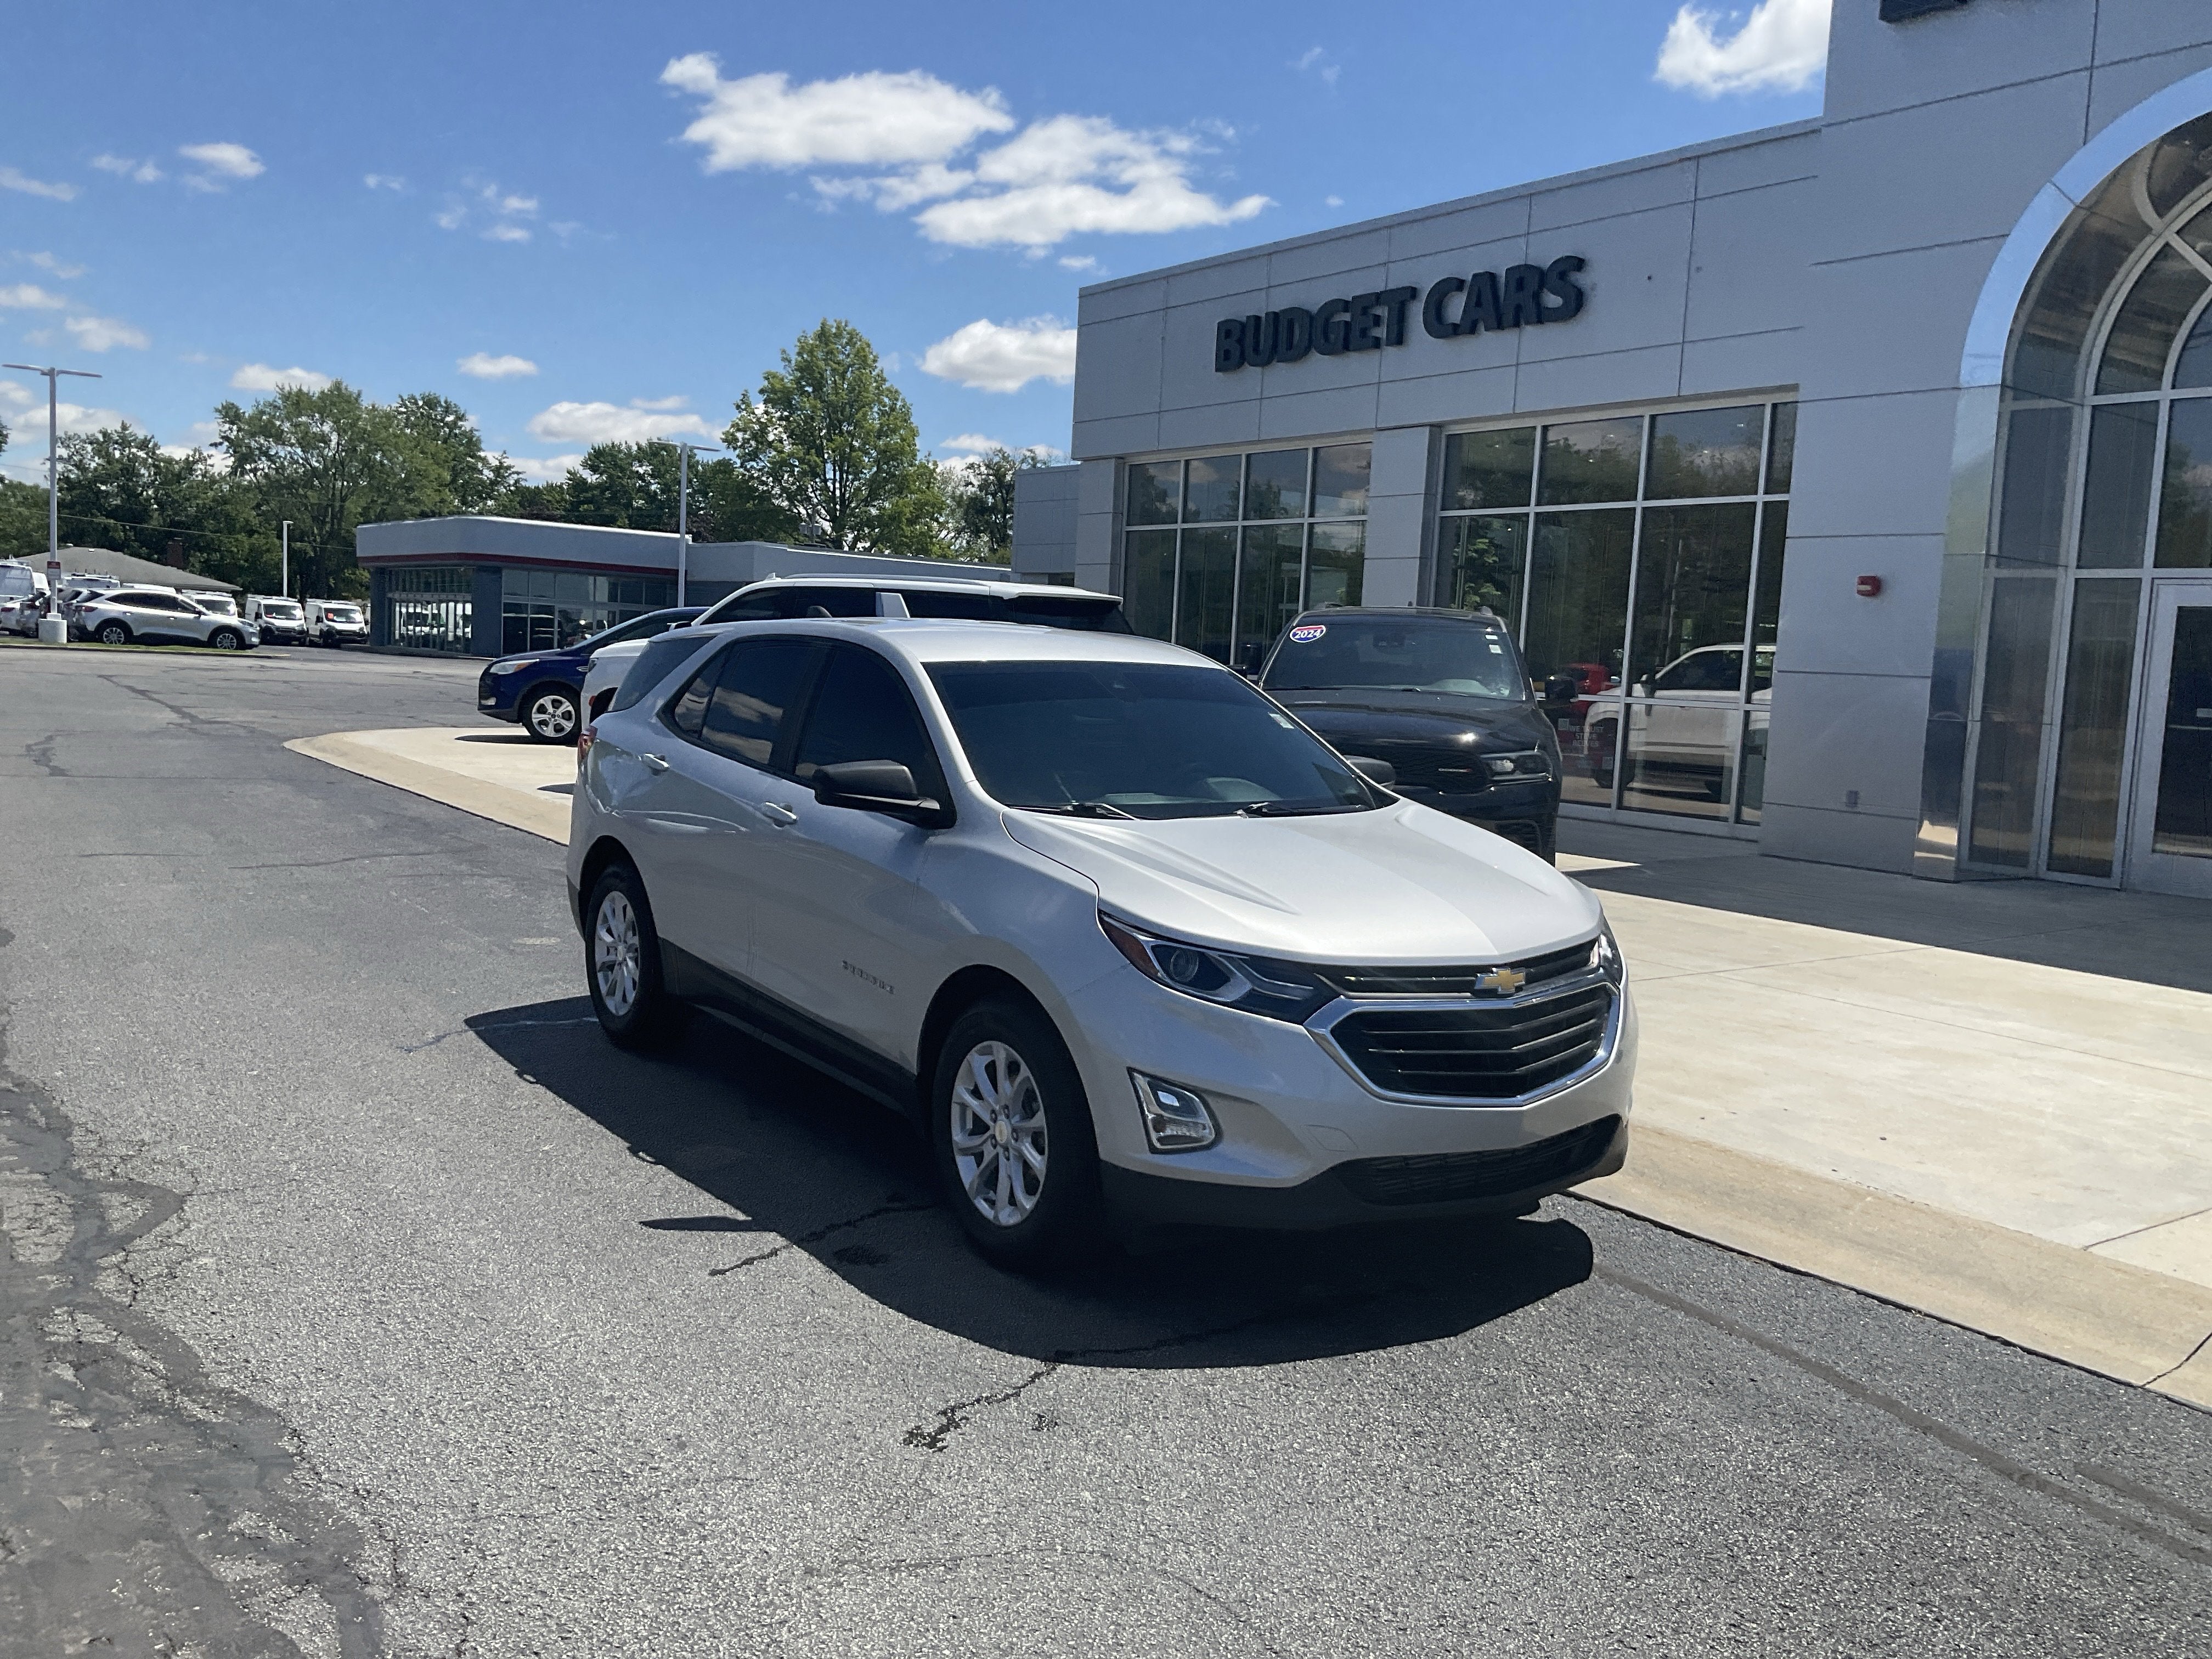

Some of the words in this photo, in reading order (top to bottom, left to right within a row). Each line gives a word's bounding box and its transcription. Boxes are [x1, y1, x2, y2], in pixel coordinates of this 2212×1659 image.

[1215, 286, 1417, 373] BUDGET
[1423, 255, 1585, 339] CARS
[1295, 629, 1321, 639] 2024
